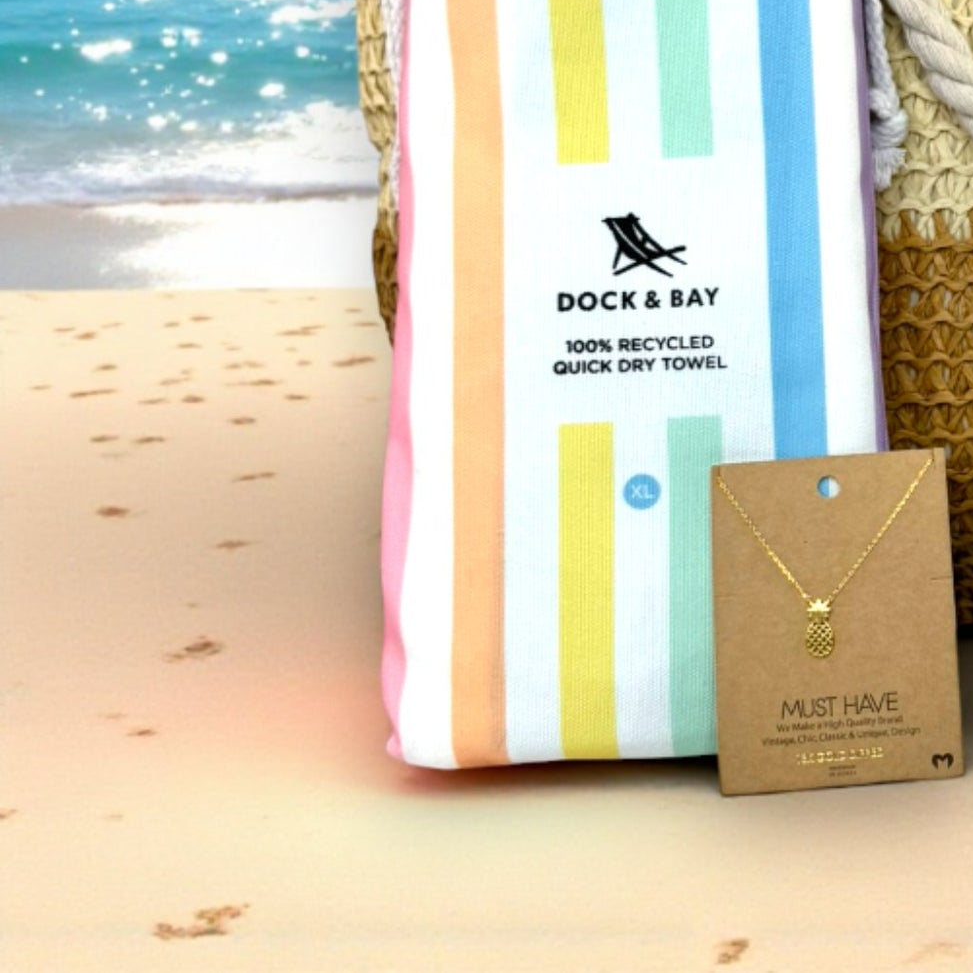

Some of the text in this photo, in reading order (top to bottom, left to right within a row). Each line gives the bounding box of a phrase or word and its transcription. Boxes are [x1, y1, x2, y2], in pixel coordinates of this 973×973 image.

[557, 287, 719, 312] DOCK & BAY
[565, 335, 715, 354] 100% RECYCLED
[552, 355, 728, 375] QUICK DRY TOWEL
[631, 484, 656, 499] XL
[781, 691, 898, 719] MUST HAVE
[846, 717, 876, 728] Quality
